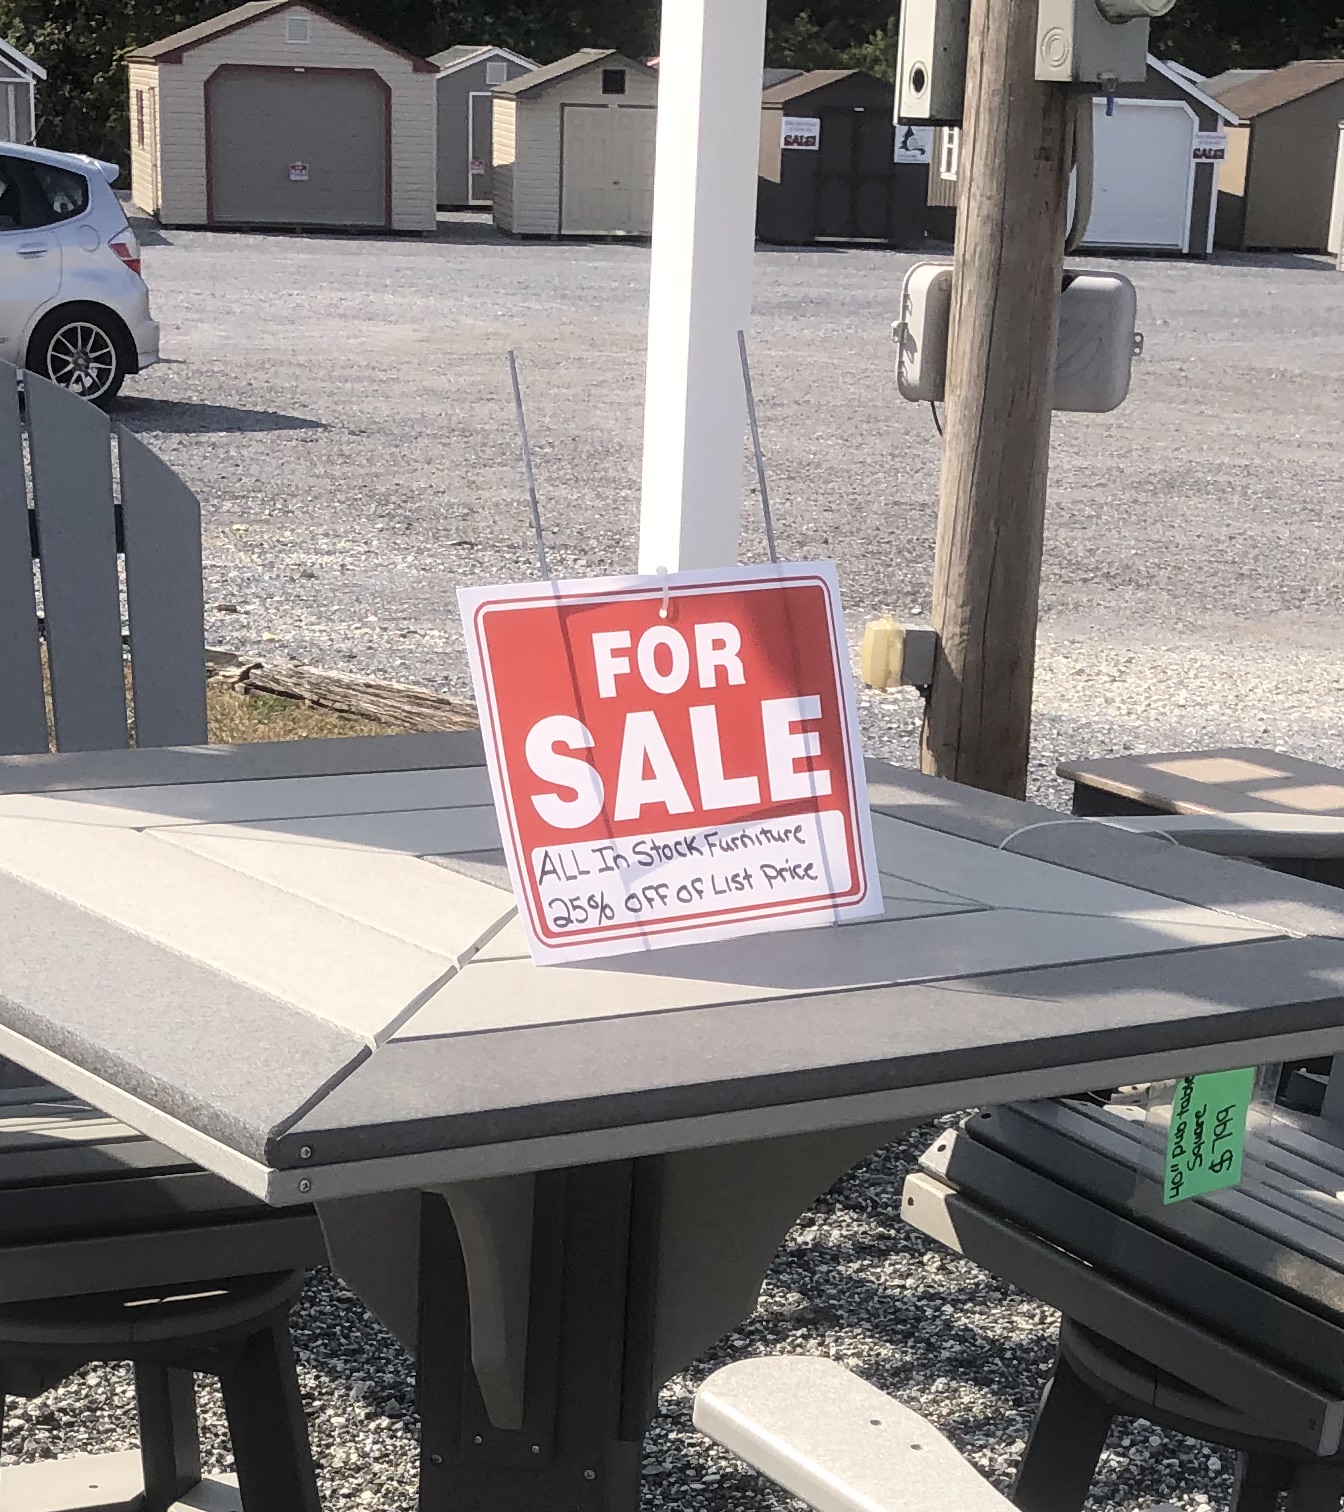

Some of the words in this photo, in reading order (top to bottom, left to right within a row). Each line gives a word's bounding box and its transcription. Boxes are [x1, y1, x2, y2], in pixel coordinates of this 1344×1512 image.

[591, 621, 746, 698] FOR
[524, 694, 833, 830] SALE
[591, 845, 630, 874] In
[703, 823, 806, 858] Furniture
[547, 889, 616, 929] 25%
[711, 867, 754, 896] List
[1187, 1103, 1208, 1172] Square
[1208, 1103, 1237, 1174] $799
